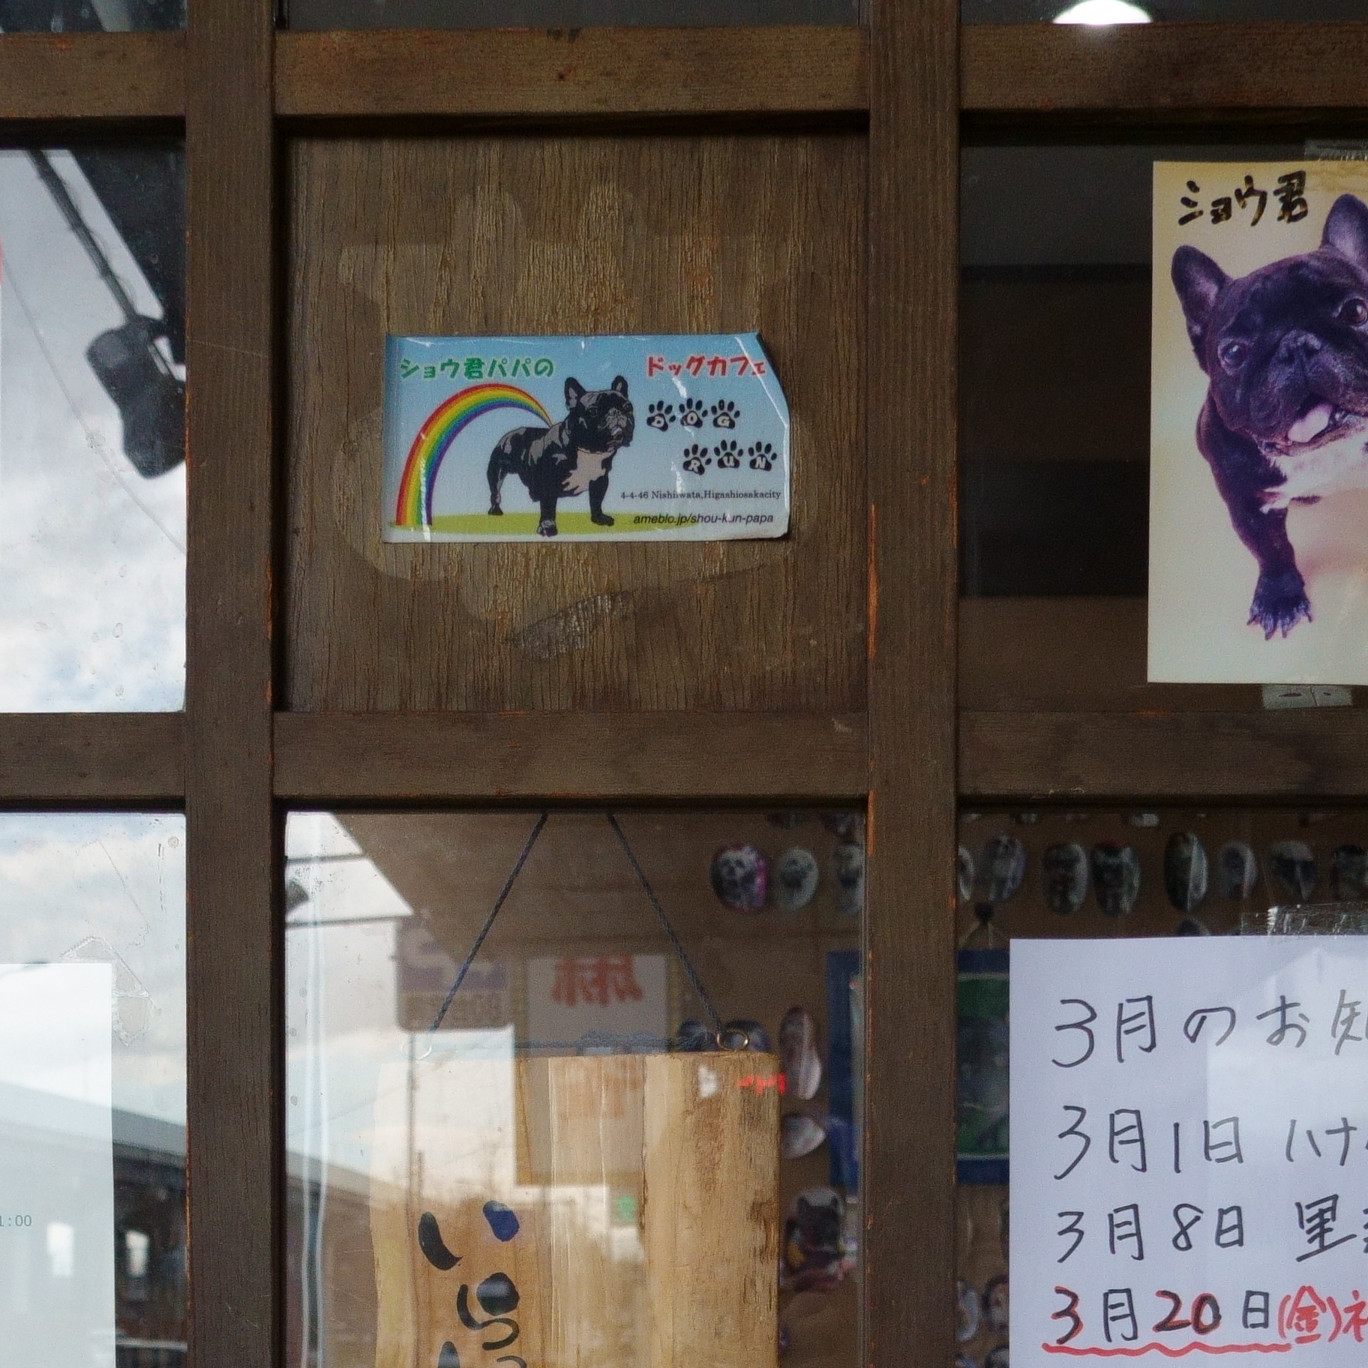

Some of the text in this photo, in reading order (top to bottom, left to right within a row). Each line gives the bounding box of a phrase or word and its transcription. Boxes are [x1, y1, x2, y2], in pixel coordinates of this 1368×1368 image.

[1177, 169, 1309, 228] ショウ君
[399, 355, 767, 381] ショウ君パパの ドッグカフェ
